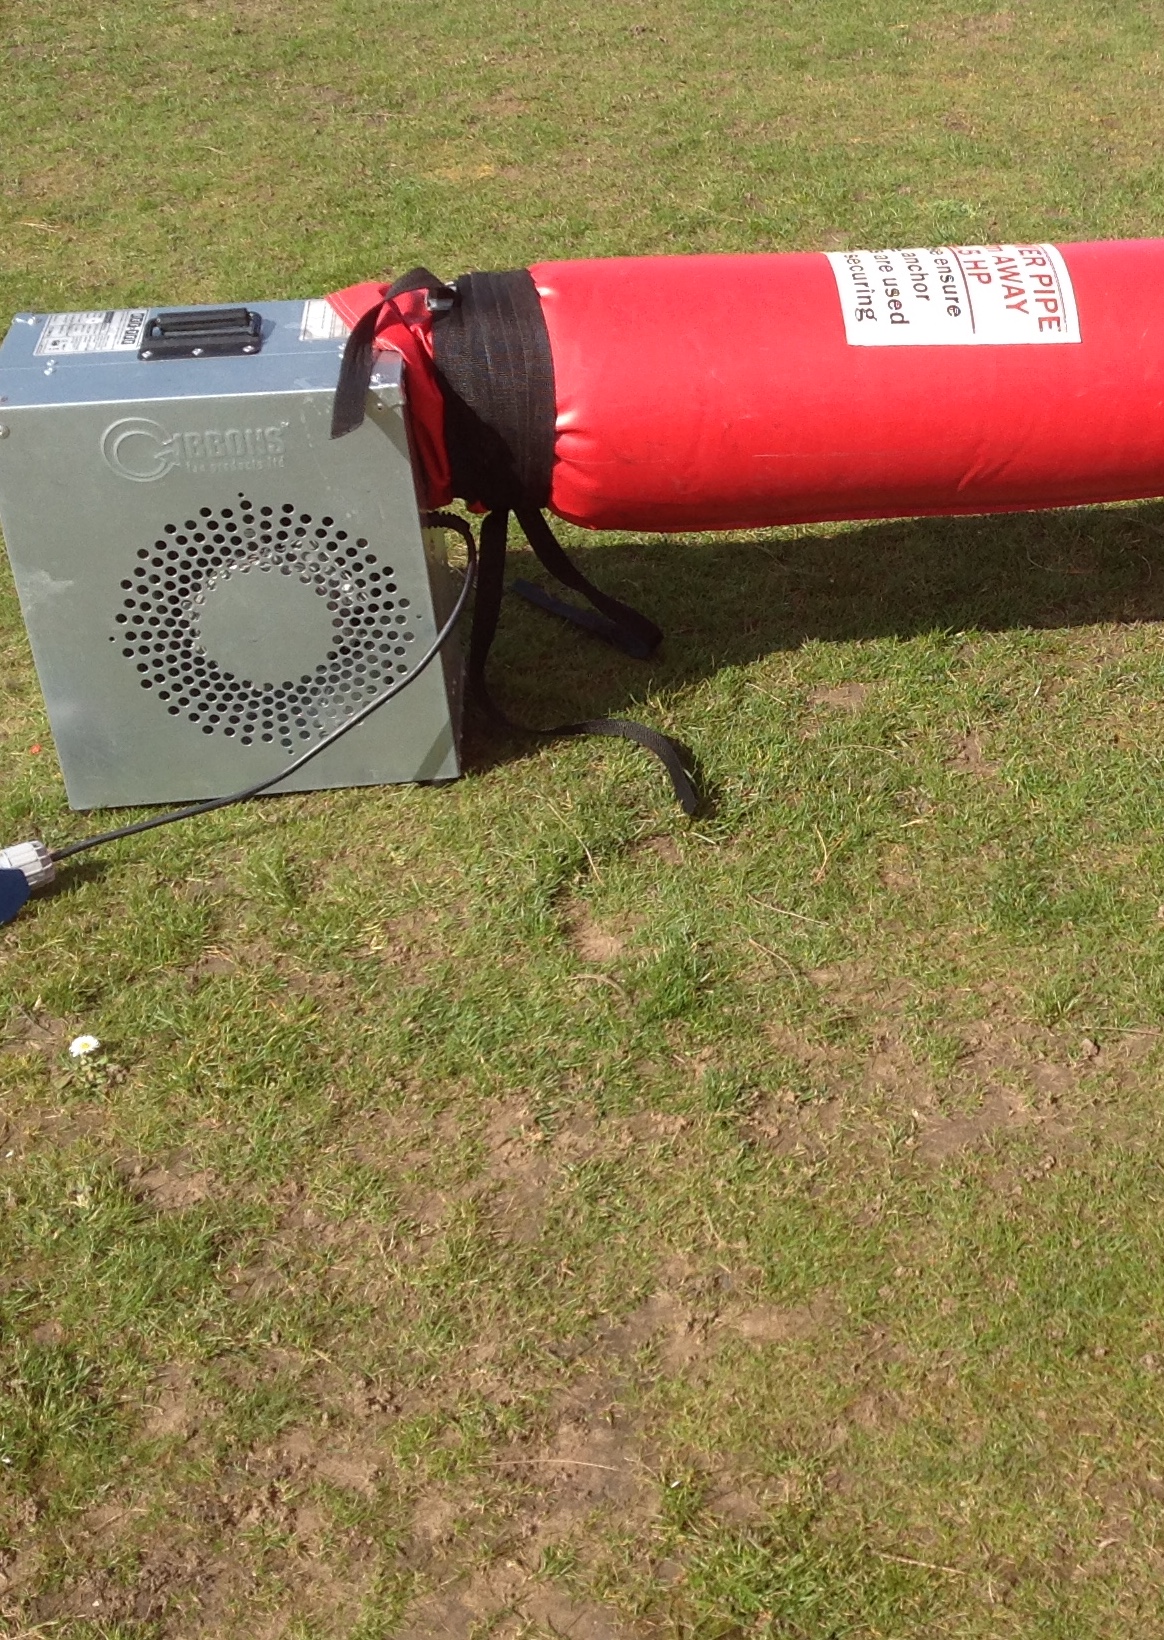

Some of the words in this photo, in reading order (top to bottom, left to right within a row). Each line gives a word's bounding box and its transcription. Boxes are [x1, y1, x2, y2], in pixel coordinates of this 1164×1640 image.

[844, 254, 878, 321] securing
[873, 254, 893, 272] are
[901, 252, 930, 301] anchor
[934, 258, 961, 317] ensure
[963, 260, 992, 284] HP
[992, 255, 1029, 314] AWAY
[882, 278, 910, 324] used
[1029, 274, 1062, 332] PIPE
